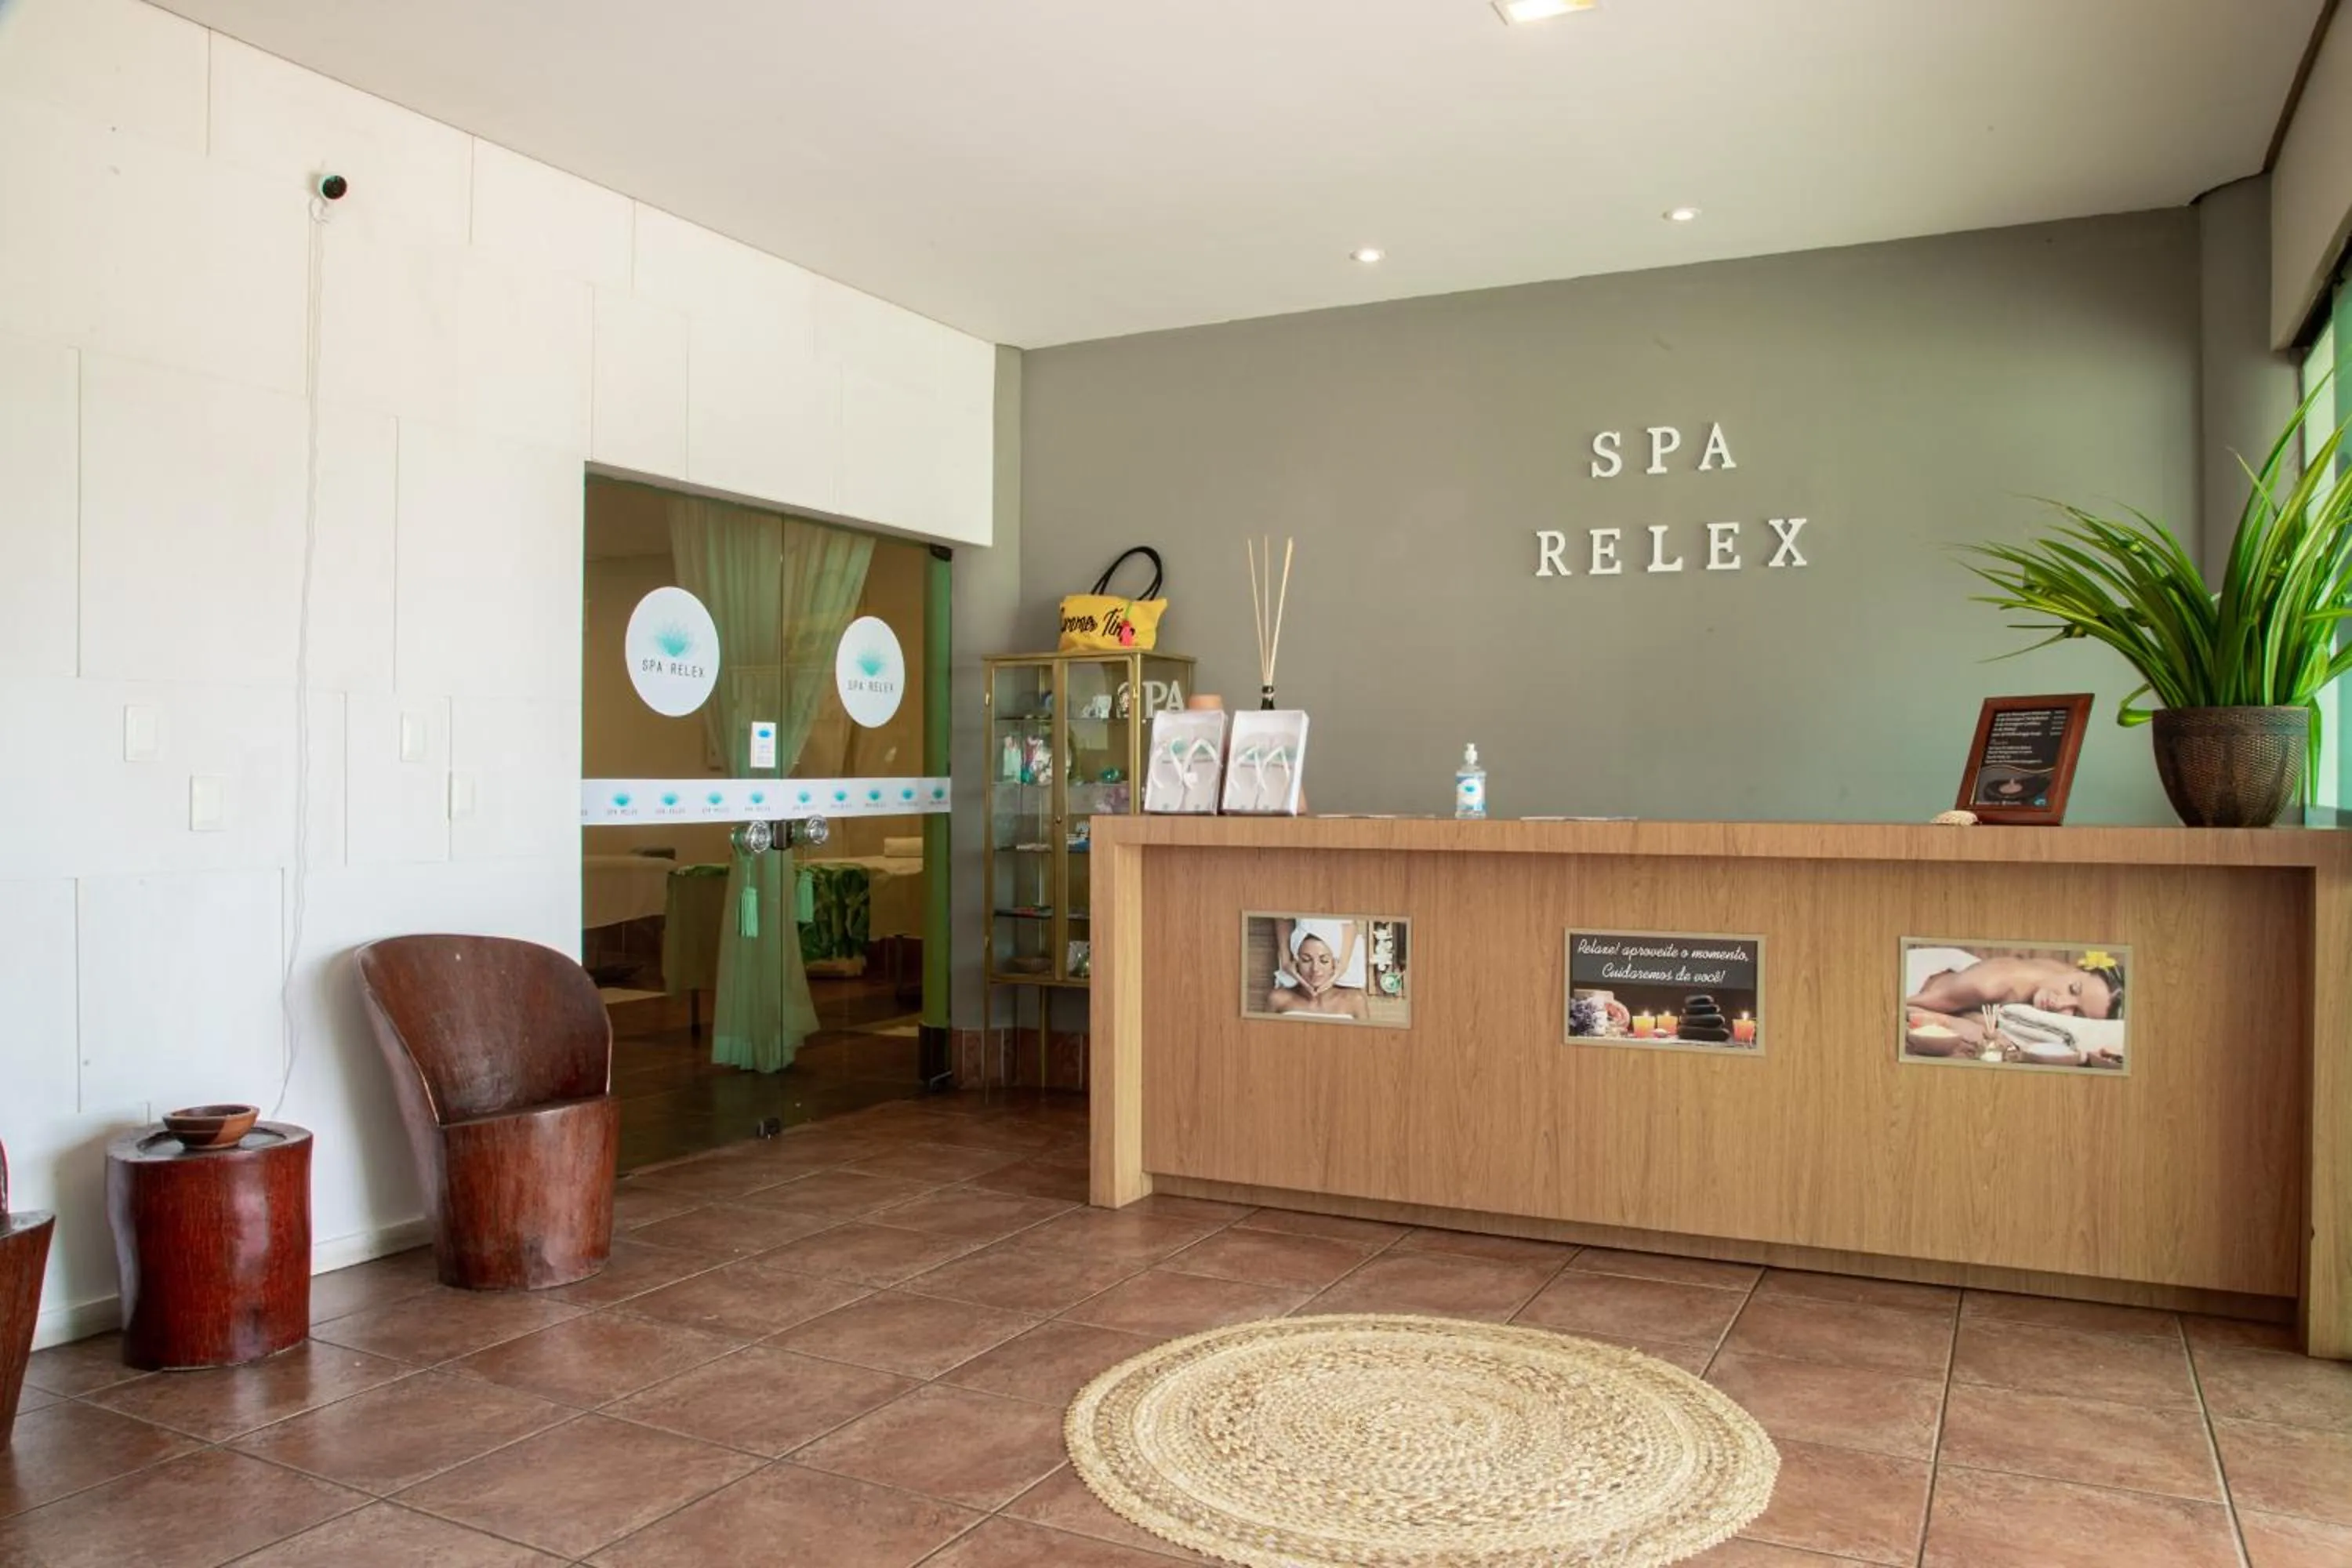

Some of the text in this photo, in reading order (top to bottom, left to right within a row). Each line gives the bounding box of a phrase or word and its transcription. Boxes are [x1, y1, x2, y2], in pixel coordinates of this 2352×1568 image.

[1592, 422, 1737, 478] SPA
[1535, 518, 1808, 577] RELEX
[641, 659, 706, 678] SPA RELEX
[1577, 938, 1621, 954] Relaxe!
[1621, 943, 1679, 961] aproveite
[1680, 949, 1689, 958] o
[1602, 962, 1726, 984] Cuidaremos de você!
